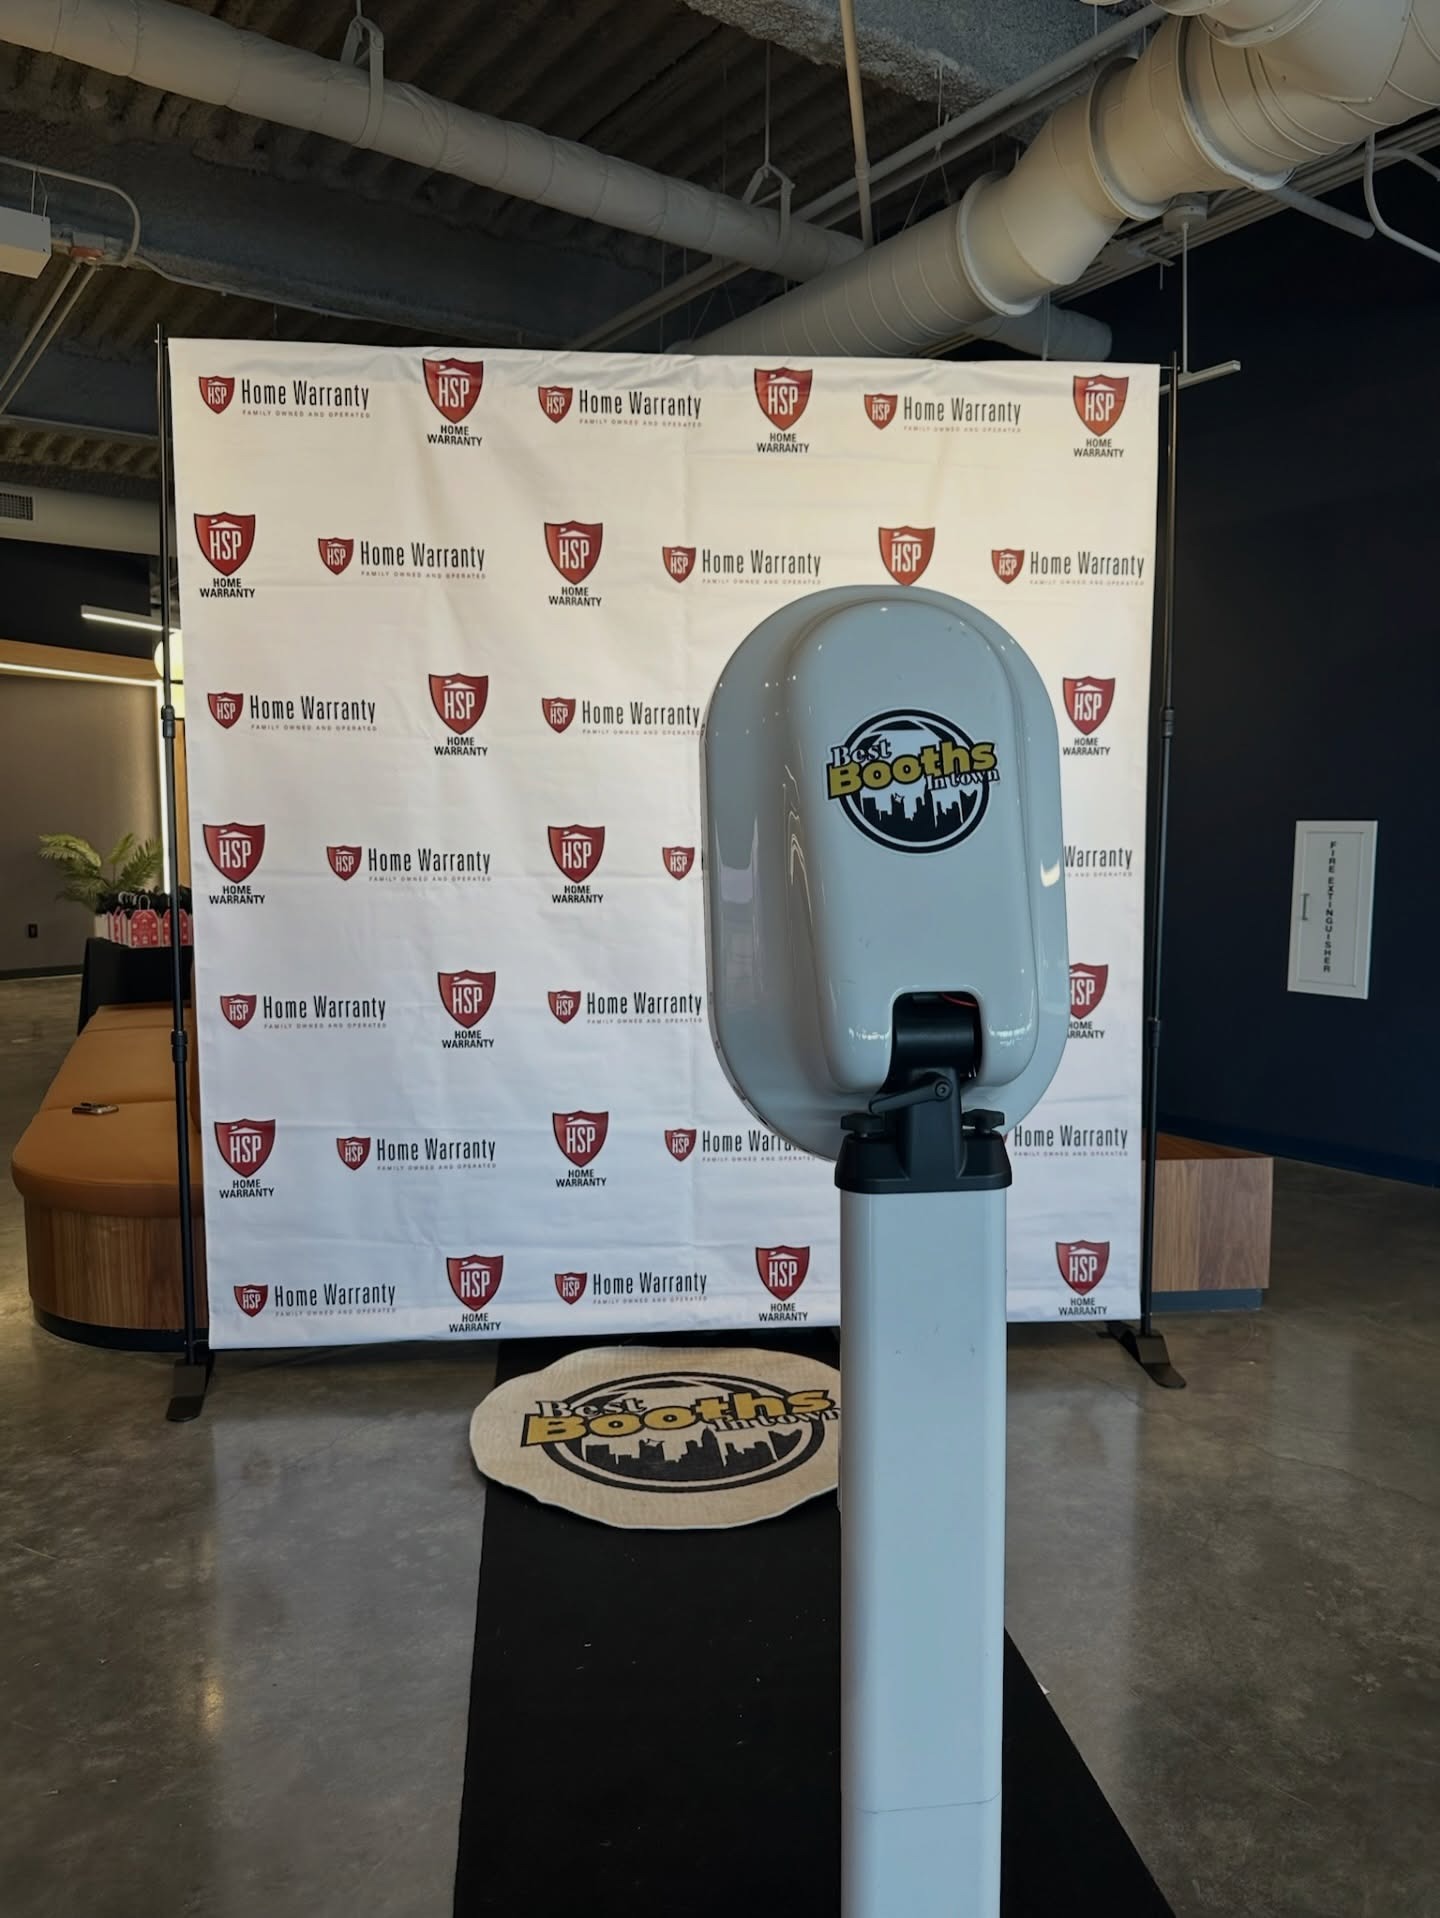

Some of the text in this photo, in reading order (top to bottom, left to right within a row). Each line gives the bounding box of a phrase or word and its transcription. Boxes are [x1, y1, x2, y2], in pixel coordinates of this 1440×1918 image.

[208, 386, 227, 405] HSP
[242, 379, 369, 411] Home Warranty
[438, 376, 470, 408] HSP
[767, 385, 799, 415] HSP
[546, 396, 565, 414] HSP
[579, 389, 701, 420] Home Warranty
[872, 403, 890, 421] HSP
[904, 396, 1021, 425] Home Warranty
[1084, 391, 1115, 421] HSP
[440, 425, 469, 436] HOME
[770, 432, 797, 442] HOME
[427, 434, 483, 446] WARRANTY
[757, 443, 810, 453] WARRANTY
[1086, 438, 1112, 448] HOME
[1073, 448, 1125, 458] WARRANTY
[210, 530, 242, 560] HSP
[327, 547, 346, 566] HSP
[360, 541, 485, 571] Home Warranty
[559, 539, 590, 570] HSP
[702, 549, 821, 577] Home Warranty
[891, 543, 922, 573] HSP
[670, 556, 689, 574] HSP
[999, 558, 1017, 576] HSP
[1030, 551, 1144, 579] Home Warranty
[212, 578, 242, 588] HOME
[561, 587, 589, 597] HOME
[199, 588, 256, 598] WARRANTY
[548, 596, 602, 607] WARRANTY
[216, 702, 236, 720] HSP
[250, 695, 376, 724] Home Warranty
[444, 690, 475, 720] HSP
[582, 700, 700, 728] Home Warranty
[1074, 692, 1102, 721] HSP
[550, 707, 568, 725] HSP
[447, 736, 475, 746] HOME
[1074, 737, 1099, 746] HOME
[434, 746, 488, 756] WARRANTY
[831, 739, 892, 767] Best
[1062, 746, 1111, 756] WARRANTY
[826, 740, 998, 800] Booths
[218, 840, 252, 868] HSP
[368, 848, 491, 875] Home Warranty
[561, 841, 592, 869] HSP
[1064, 845, 1133, 870] Warranty
[336, 855, 354, 872] HSP
[670, 855, 688, 872] HSP
[222, 885, 252, 895] HOME
[564, 885, 591, 894] HOME
[209, 894, 266, 905] WARRANTY
[552, 894, 604, 904] WARRANTY
[1323, 841, 1336, 973] FIRE EXTINGUISHER
[263, 995, 386, 1021] Home Warranty
[452, 986, 483, 1014] HSP
[555, 999, 574, 1016] HSP
[587, 992, 702, 1016] Home Warranty
[229, 1004, 248, 1021] HSP
[442, 1038, 495, 1049] WARRANTY
[454, 1030, 482, 1040] HOME
[566, 1126, 596, 1154] HSP
[672, 1137, 690, 1154] HSP
[702, 1130, 742, 1152] Home
[1014, 1125, 1128, 1150] Home Warranty
[229, 1135, 262, 1163] HSP
[345, 1146, 363, 1162] HSP
[377, 1138, 496, 1161] Home Warranty
[556, 1177, 607, 1188] WARRANTY
[568, 1169, 594, 1178] HOME
[232, 1178, 261, 1189] HOME
[219, 1188, 275, 1199] WARRANTY
[769, 1261, 798, 1287] HSP
[1069, 1256, 1098, 1282] HSP
[461, 1270, 491, 1298] HSP
[562, 1280, 580, 1297] HSP
[593, 1272, 707, 1295] Home Warranty
[242, 1292, 261, 1310] HSP
[275, 1283, 396, 1307] Home Warranty
[1070, 1297, 1096, 1306] HOME
[770, 1303, 796, 1312] HOME
[1058, 1306, 1108, 1316] WARRANTY
[462, 1312, 489, 1322] HOME
[758, 1312, 808, 1322] WARRANTY
[448, 1322, 501, 1333] WARRANTY
[536, 1397, 648, 1418] Best
[520, 1390, 836, 1447] Booths
